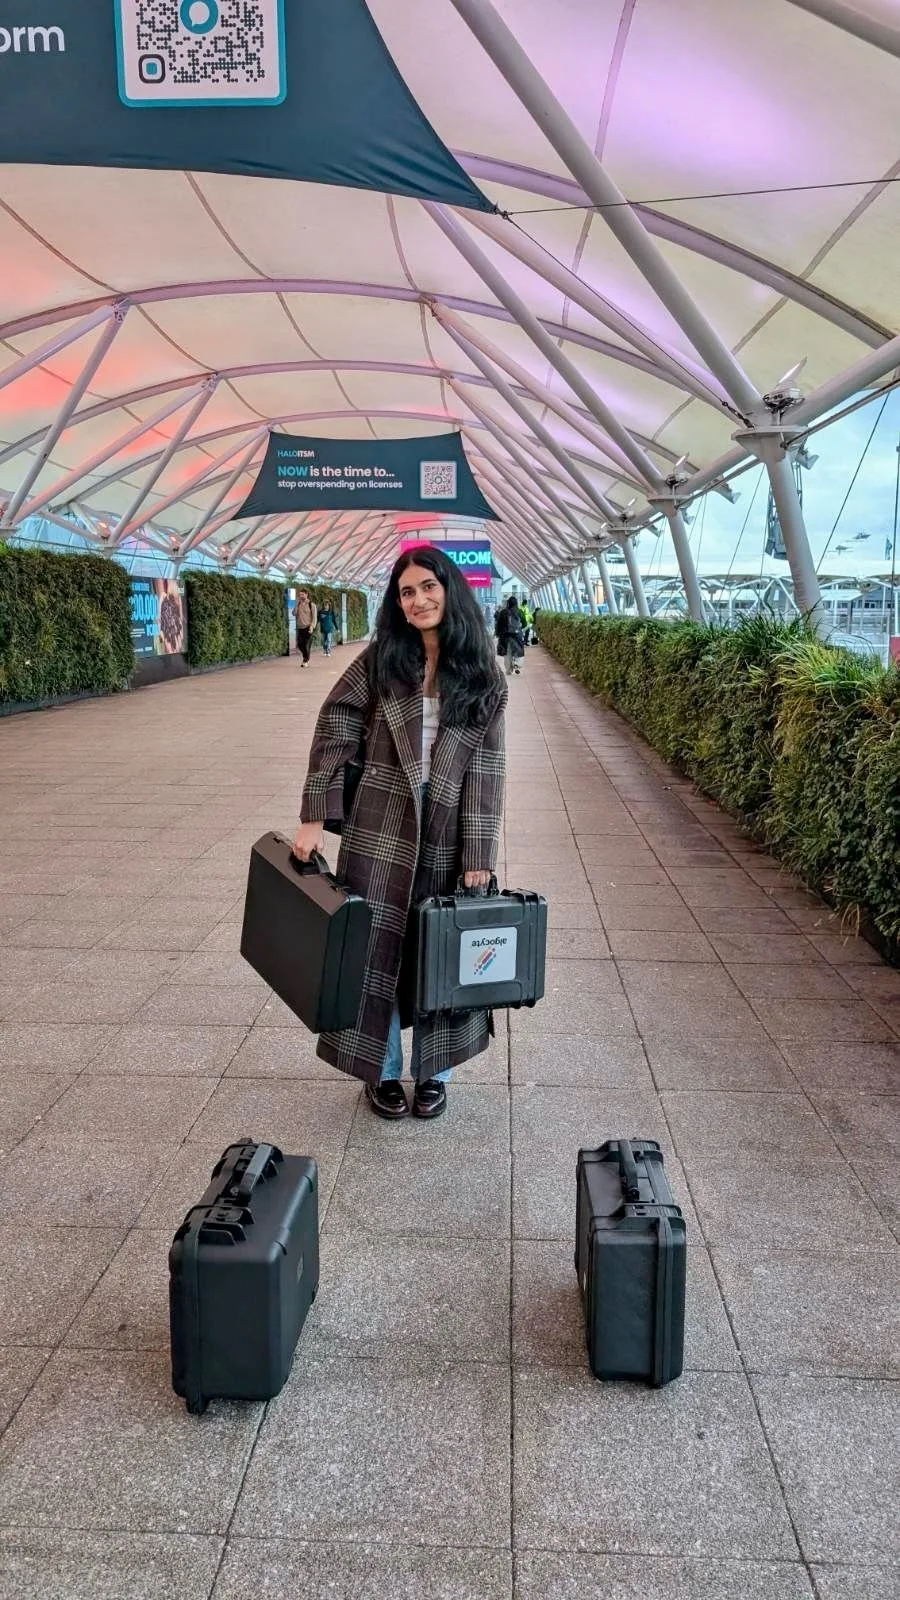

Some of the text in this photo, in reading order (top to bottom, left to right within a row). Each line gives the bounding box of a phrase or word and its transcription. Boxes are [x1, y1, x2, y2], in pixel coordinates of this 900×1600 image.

[278, 465, 395, 477] NOW is the time to...
[278, 480, 297, 490] stop
[297, 480, 356, 491] overspending
[369, 480, 403, 489] licenses
[446, 551, 491, 564] ELCOM
[471, 936, 507, 947] algocyte
